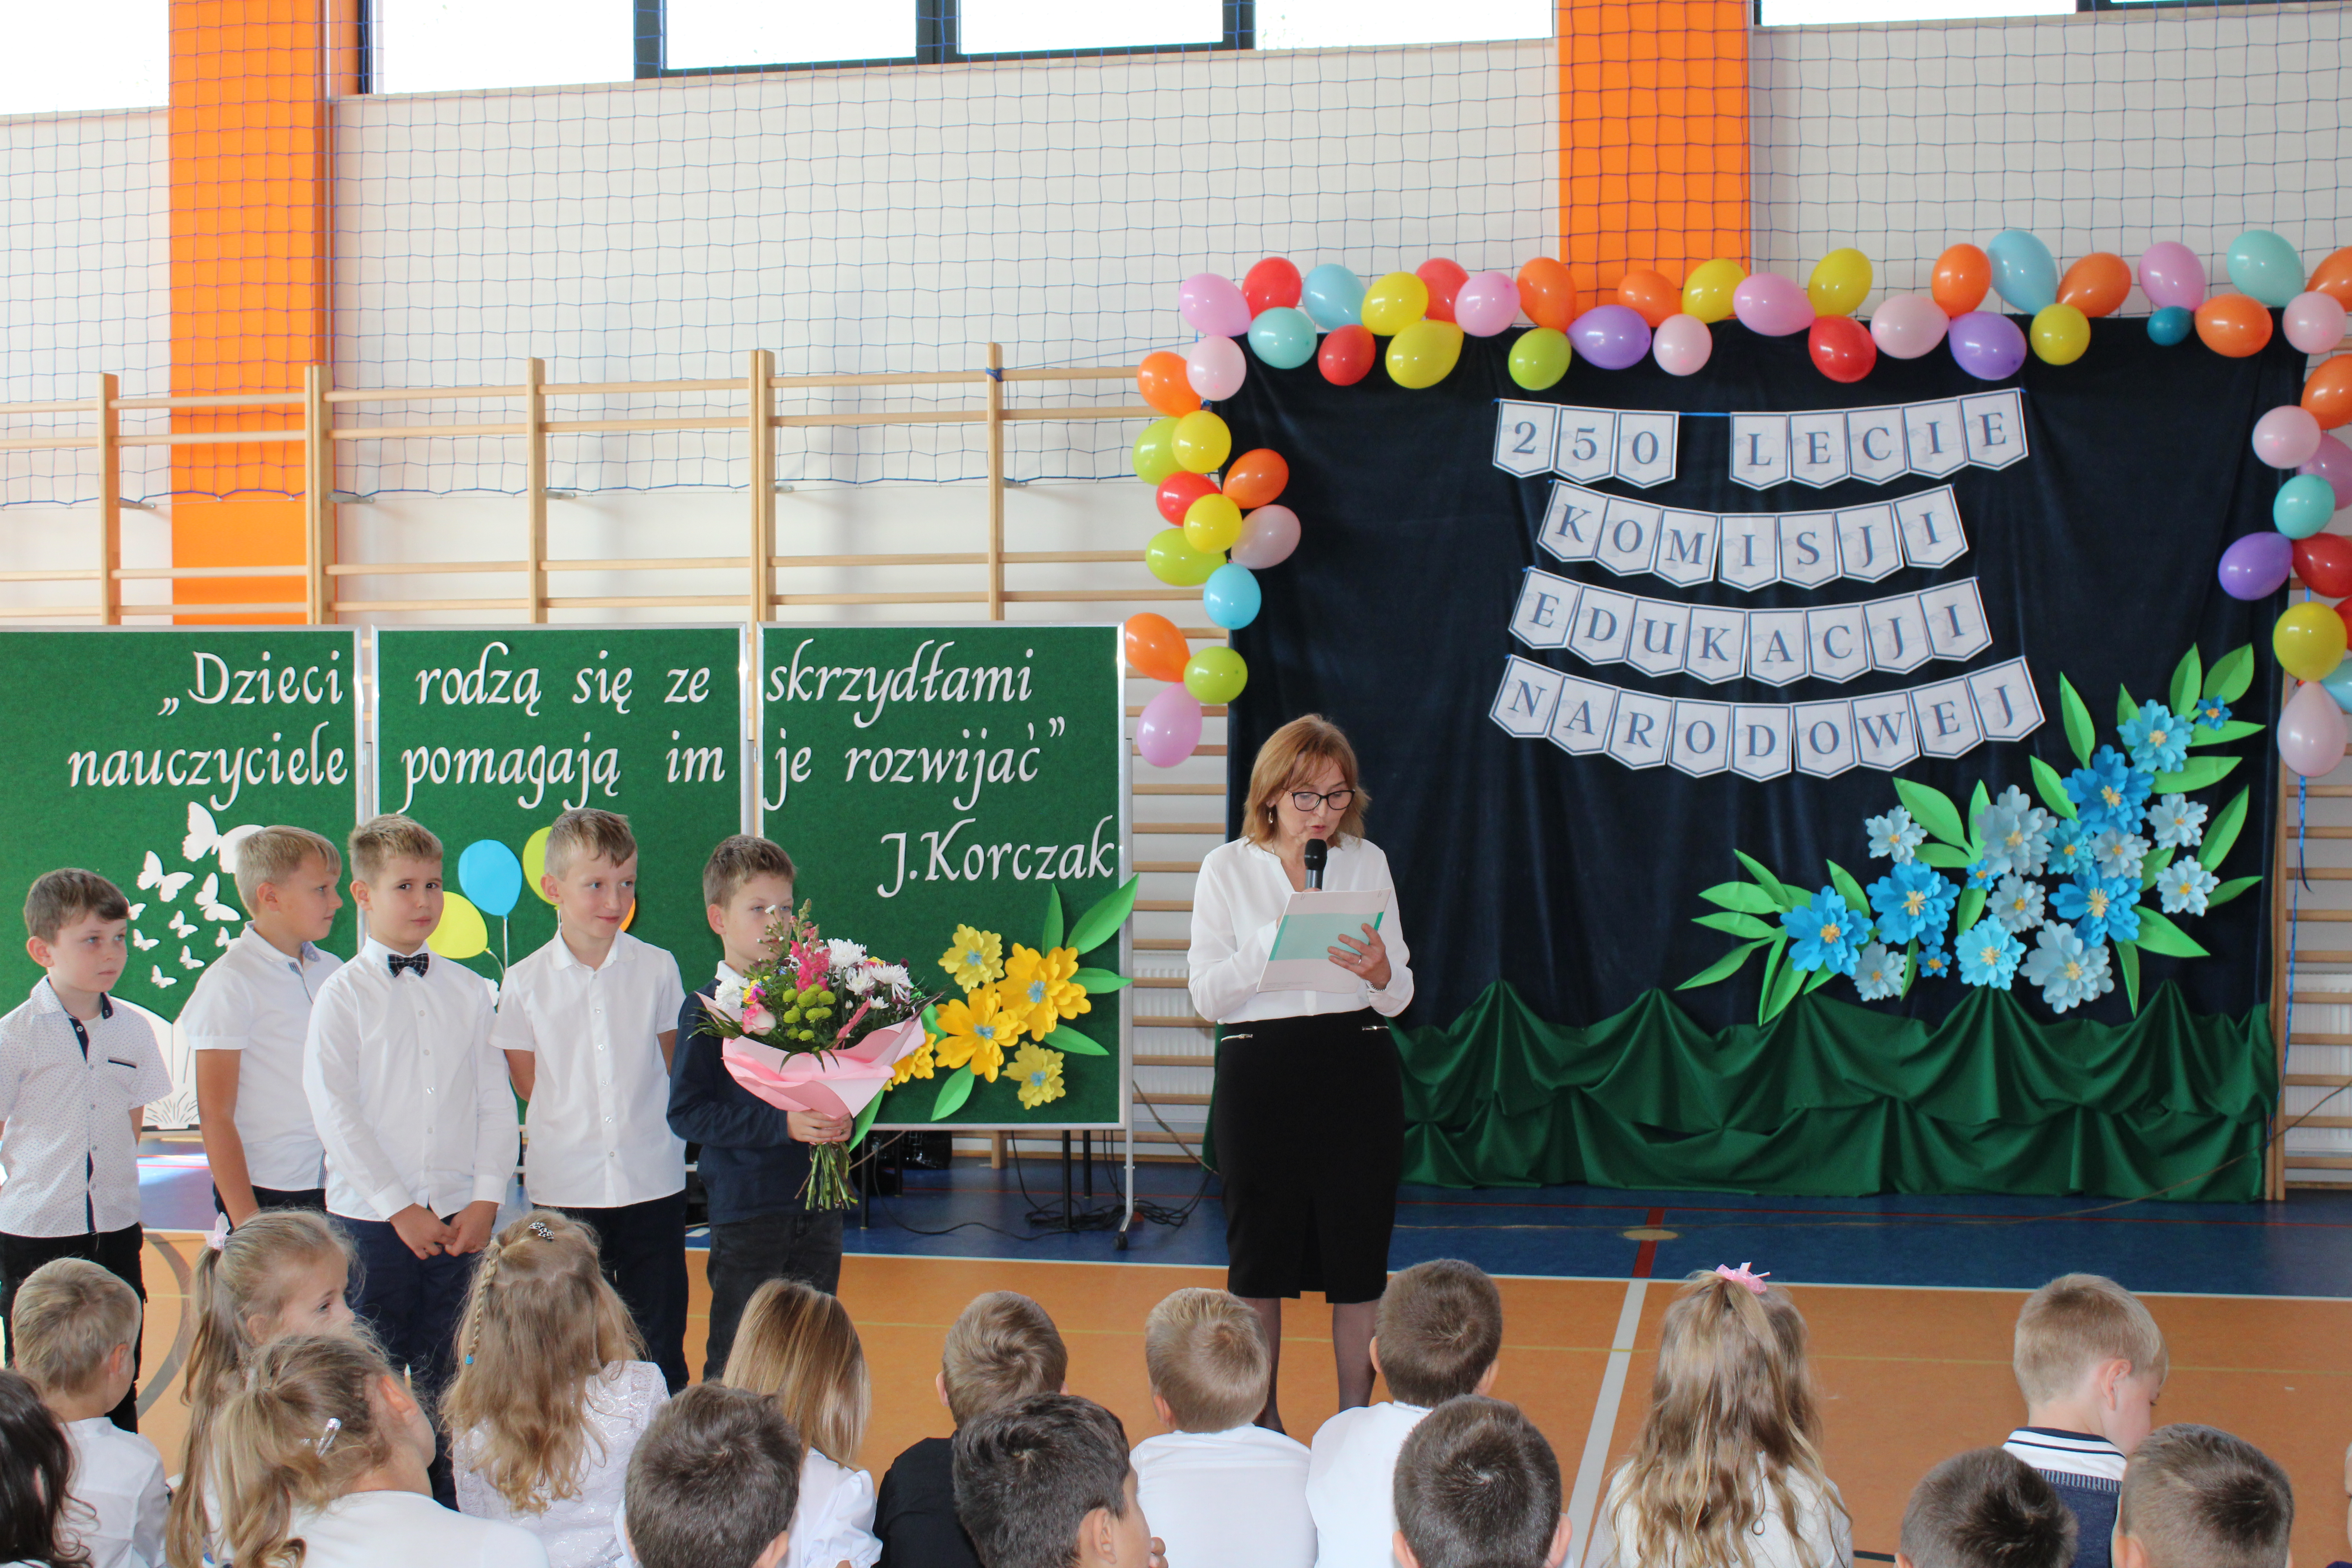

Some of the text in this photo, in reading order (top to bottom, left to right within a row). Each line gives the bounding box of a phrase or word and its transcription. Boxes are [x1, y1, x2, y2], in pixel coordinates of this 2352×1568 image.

[1513, 411, 2007, 467] 250 LECIE
[1555, 503, 1941, 568] KOMISJI
[1530, 592, 1965, 663] EDUKACJI
[415, 641, 541, 717] rodzą
[572, 650, 632, 714] się
[664, 667, 710, 703] ze
[766, 638, 1034, 729] skrzydłami
[1506, 679, 2016, 757] NARODOWEJ
[67, 721, 348, 811] nauczyciele
[396, 732, 621, 814] pomagają
[666, 730, 725, 782] im
[762, 728, 811, 811] je
[877, 815, 1115, 898] J.Korczak
